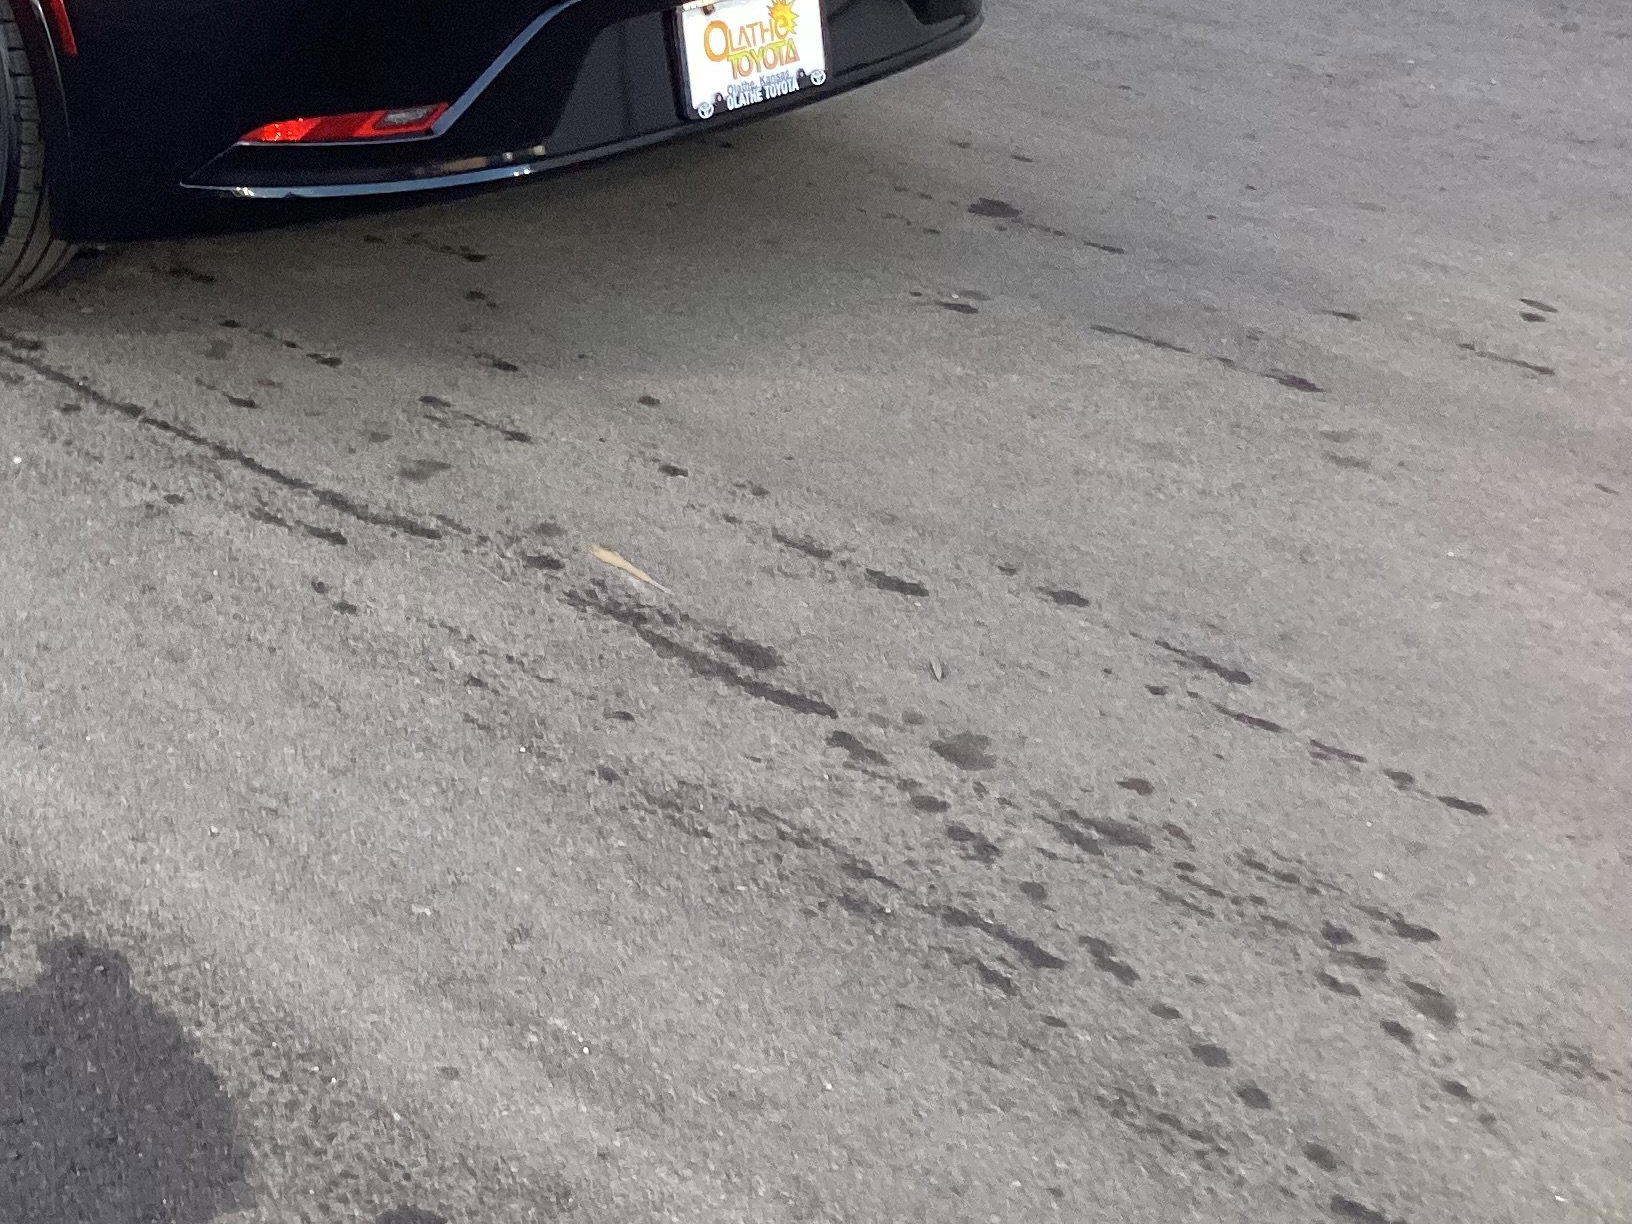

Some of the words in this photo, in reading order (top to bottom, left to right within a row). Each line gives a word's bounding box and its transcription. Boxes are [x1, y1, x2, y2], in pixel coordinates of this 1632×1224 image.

[727, 38, 801, 80] TOYOTA
[726, 87, 764, 111] OLATHE
[764, 77, 800, 99] TOYOTA
